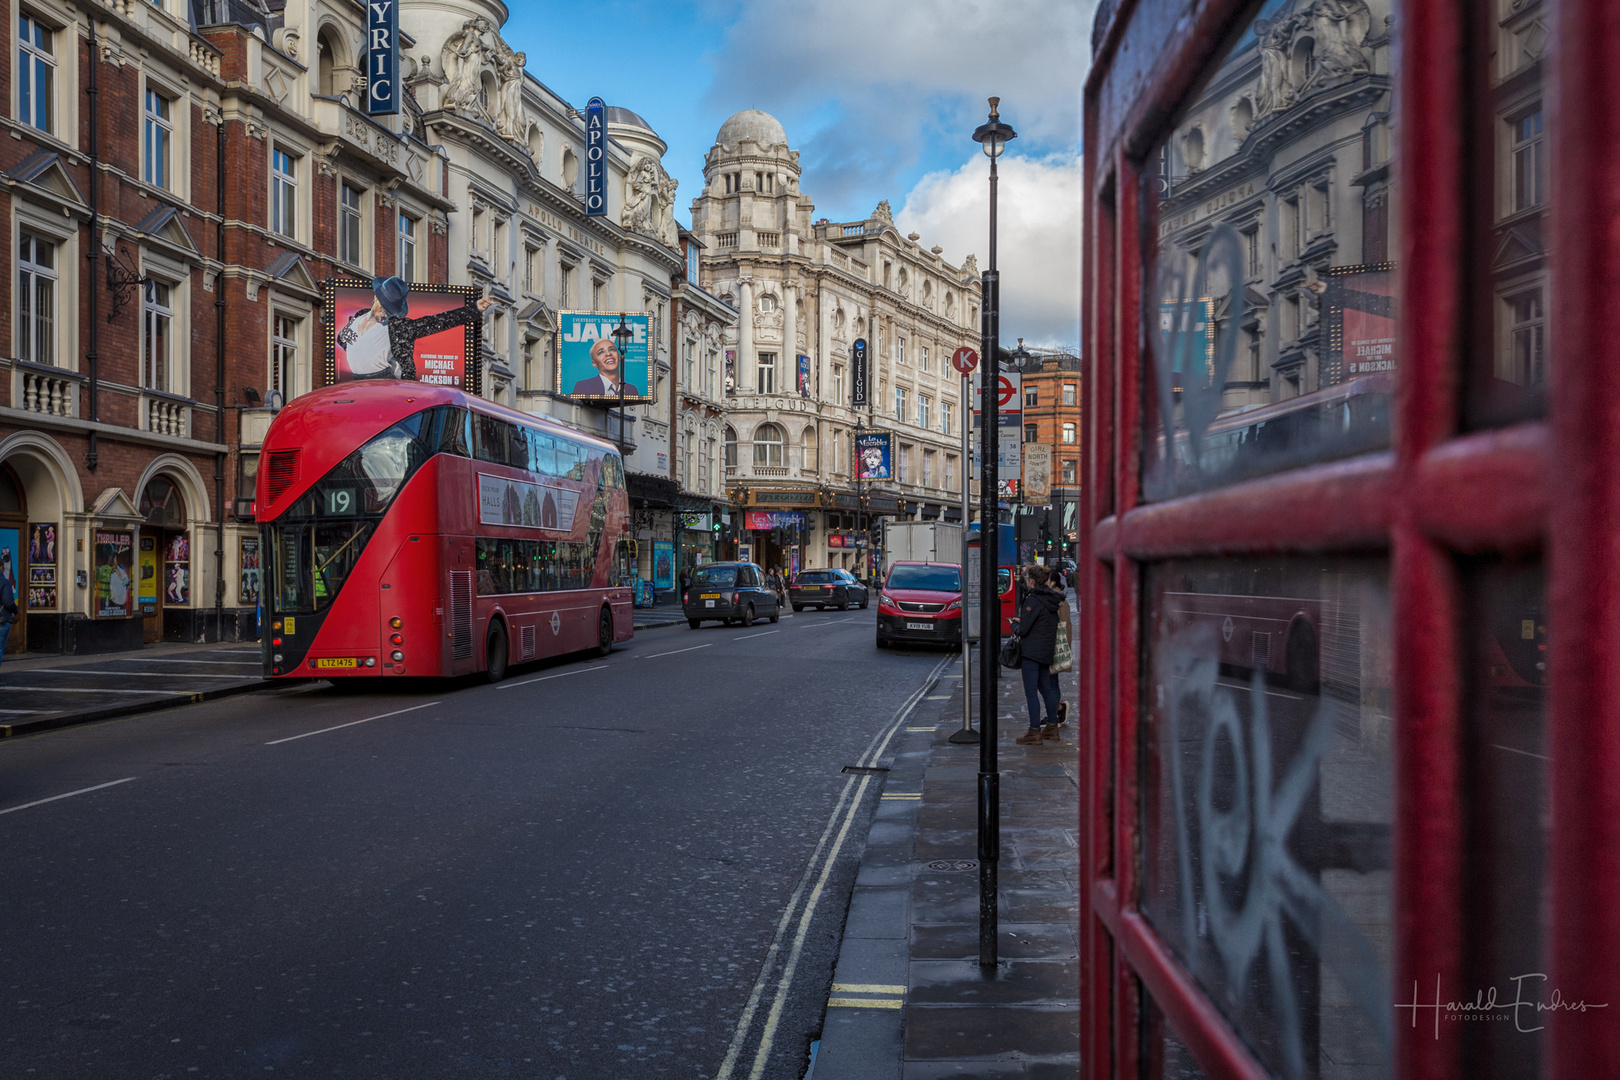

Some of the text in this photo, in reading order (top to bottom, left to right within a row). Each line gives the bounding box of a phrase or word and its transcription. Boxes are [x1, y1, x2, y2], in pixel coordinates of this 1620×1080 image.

[588, 115, 602, 209] APOLLO
[529, 203, 604, 256] APOLLO THEATRE
[424, 359, 455, 370] MICHAEL
[960, 351, 974, 368] K
[420, 374, 460, 386] JACKSON 5
[728, 398, 807, 412] GIELGUD
[1030, 445, 1046, 453] GIRL
[331, 491, 350, 513] 19
[482, 496, 500, 508] HALLS
[751, 513, 766, 523] Les
[96, 533, 130, 545] THRILLER
